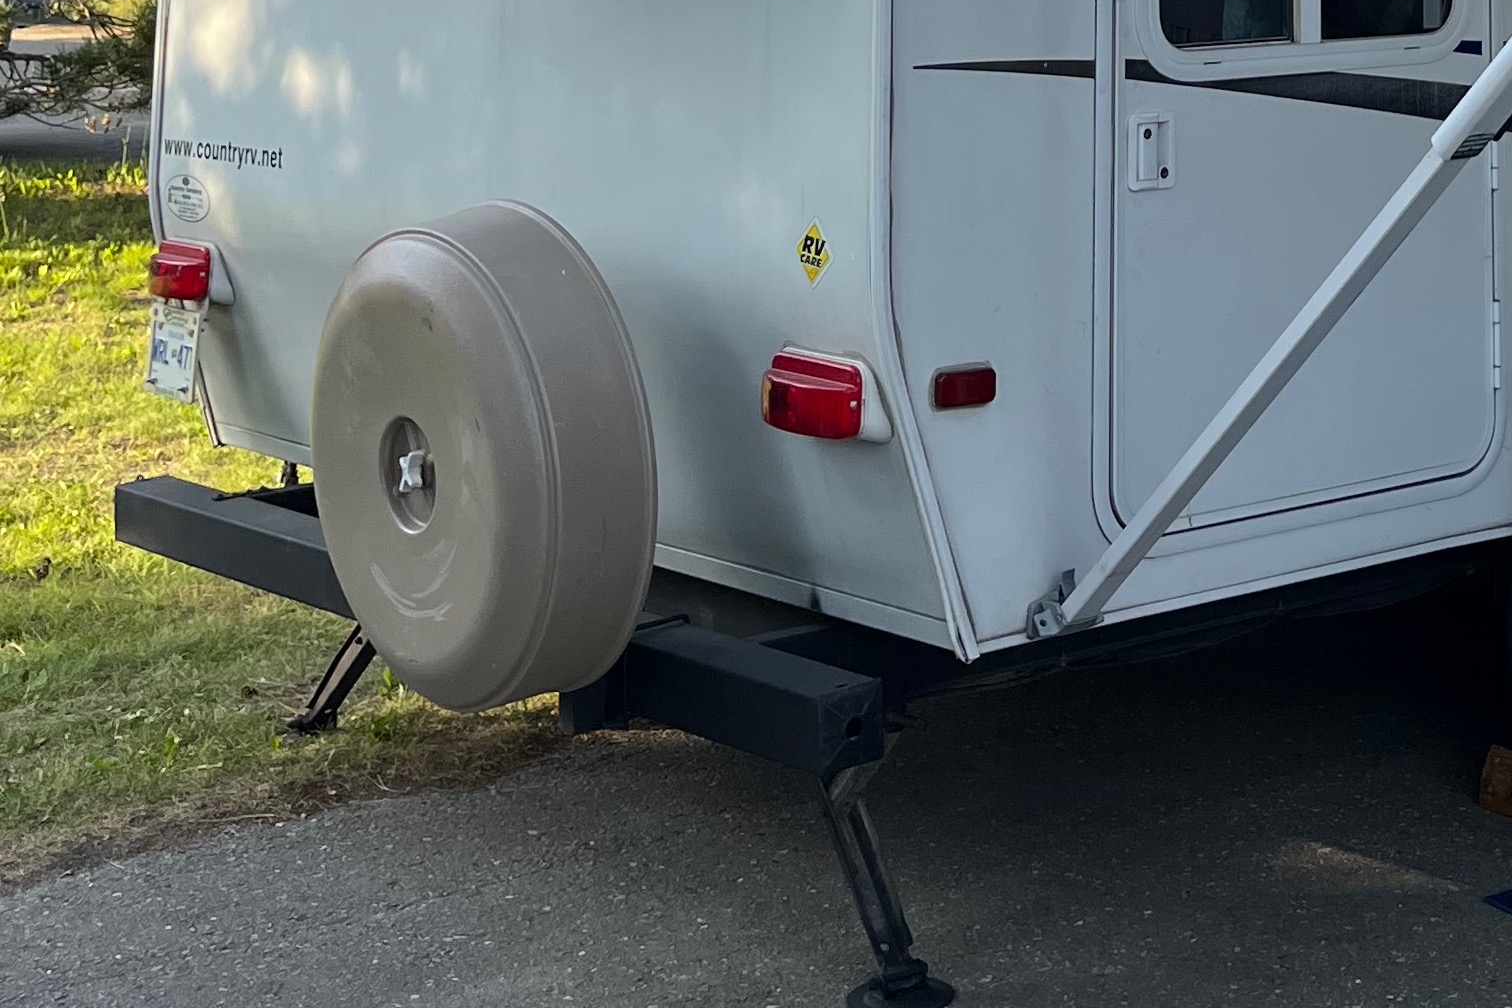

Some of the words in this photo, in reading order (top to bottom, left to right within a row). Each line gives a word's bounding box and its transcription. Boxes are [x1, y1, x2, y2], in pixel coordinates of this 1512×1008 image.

[164, 138, 283, 169] www.countryrv.net
[802, 235, 826, 256] RV
[800, 254, 822, 268] CARE
